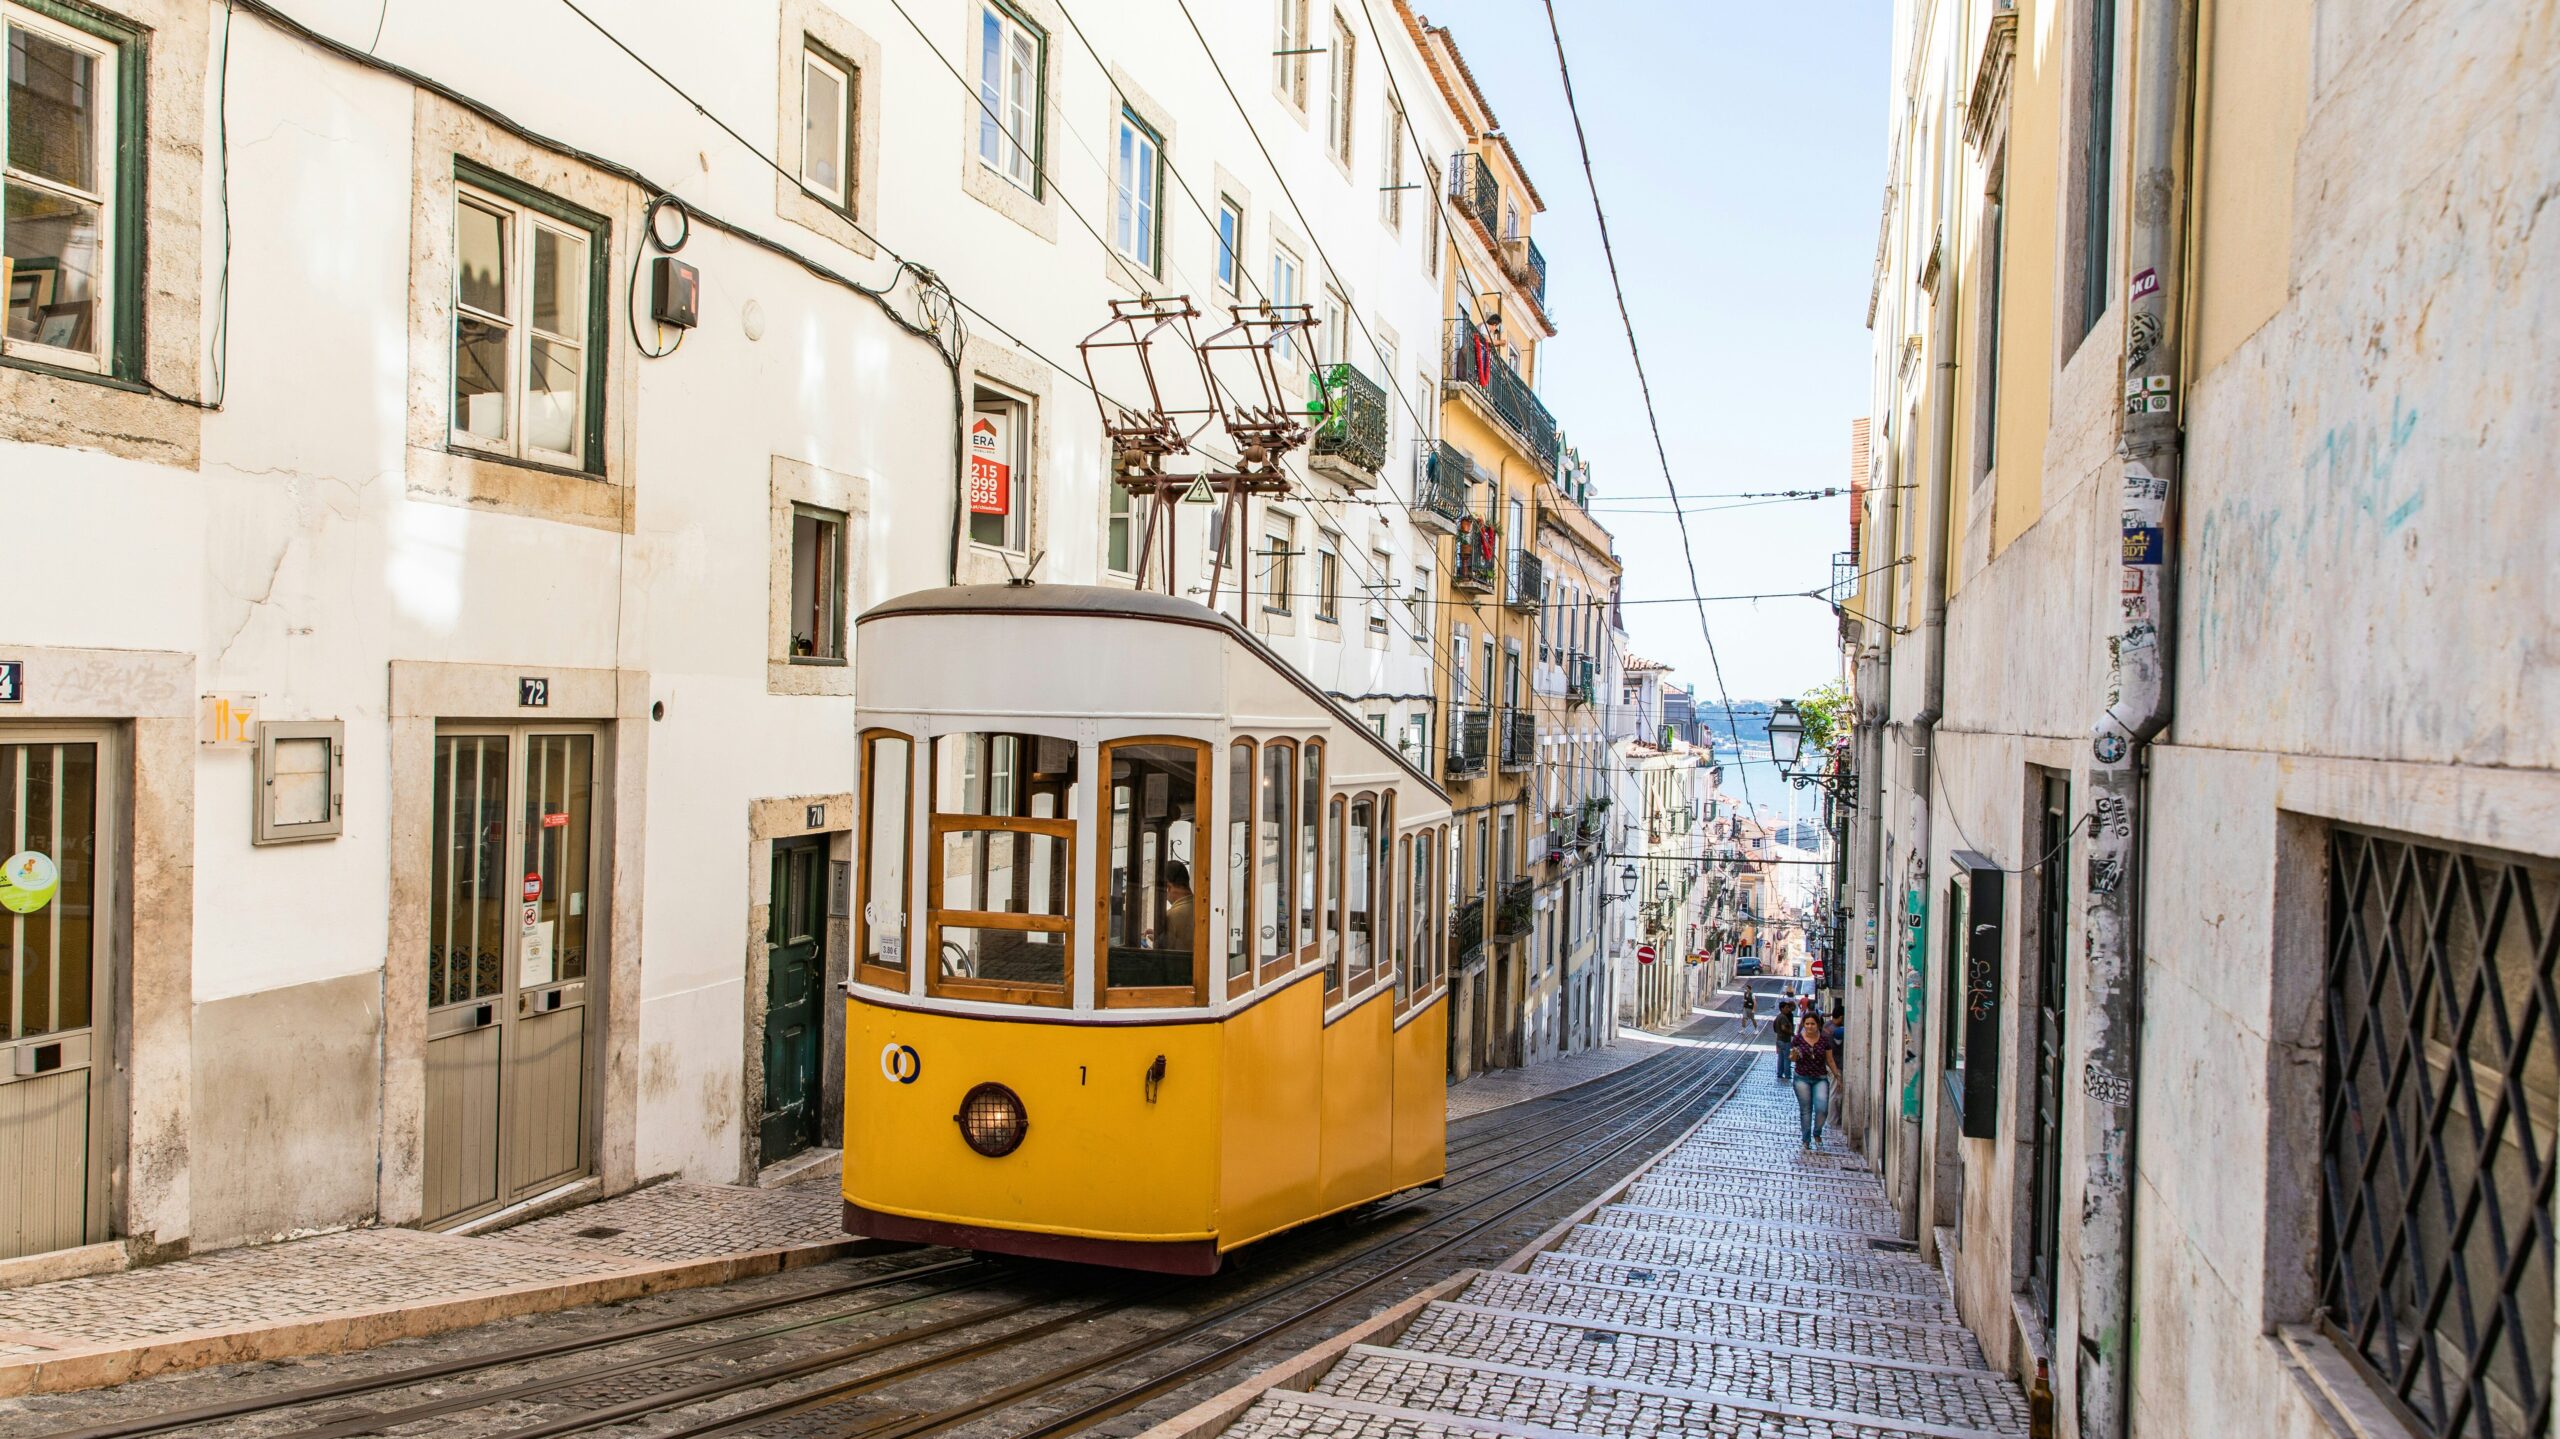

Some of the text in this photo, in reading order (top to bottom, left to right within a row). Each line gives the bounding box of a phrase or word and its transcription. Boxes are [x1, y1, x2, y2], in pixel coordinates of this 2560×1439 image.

[973, 435, 995, 447] ERA
[972, 463, 998, 478] 215
[971, 477, 998, 491] 999
[971, 490, 998, 504] 995
[525, 680, 545, 705] 72
[811, 806, 823, 826] 70
[1079, 1065, 1087, 1086] 1
